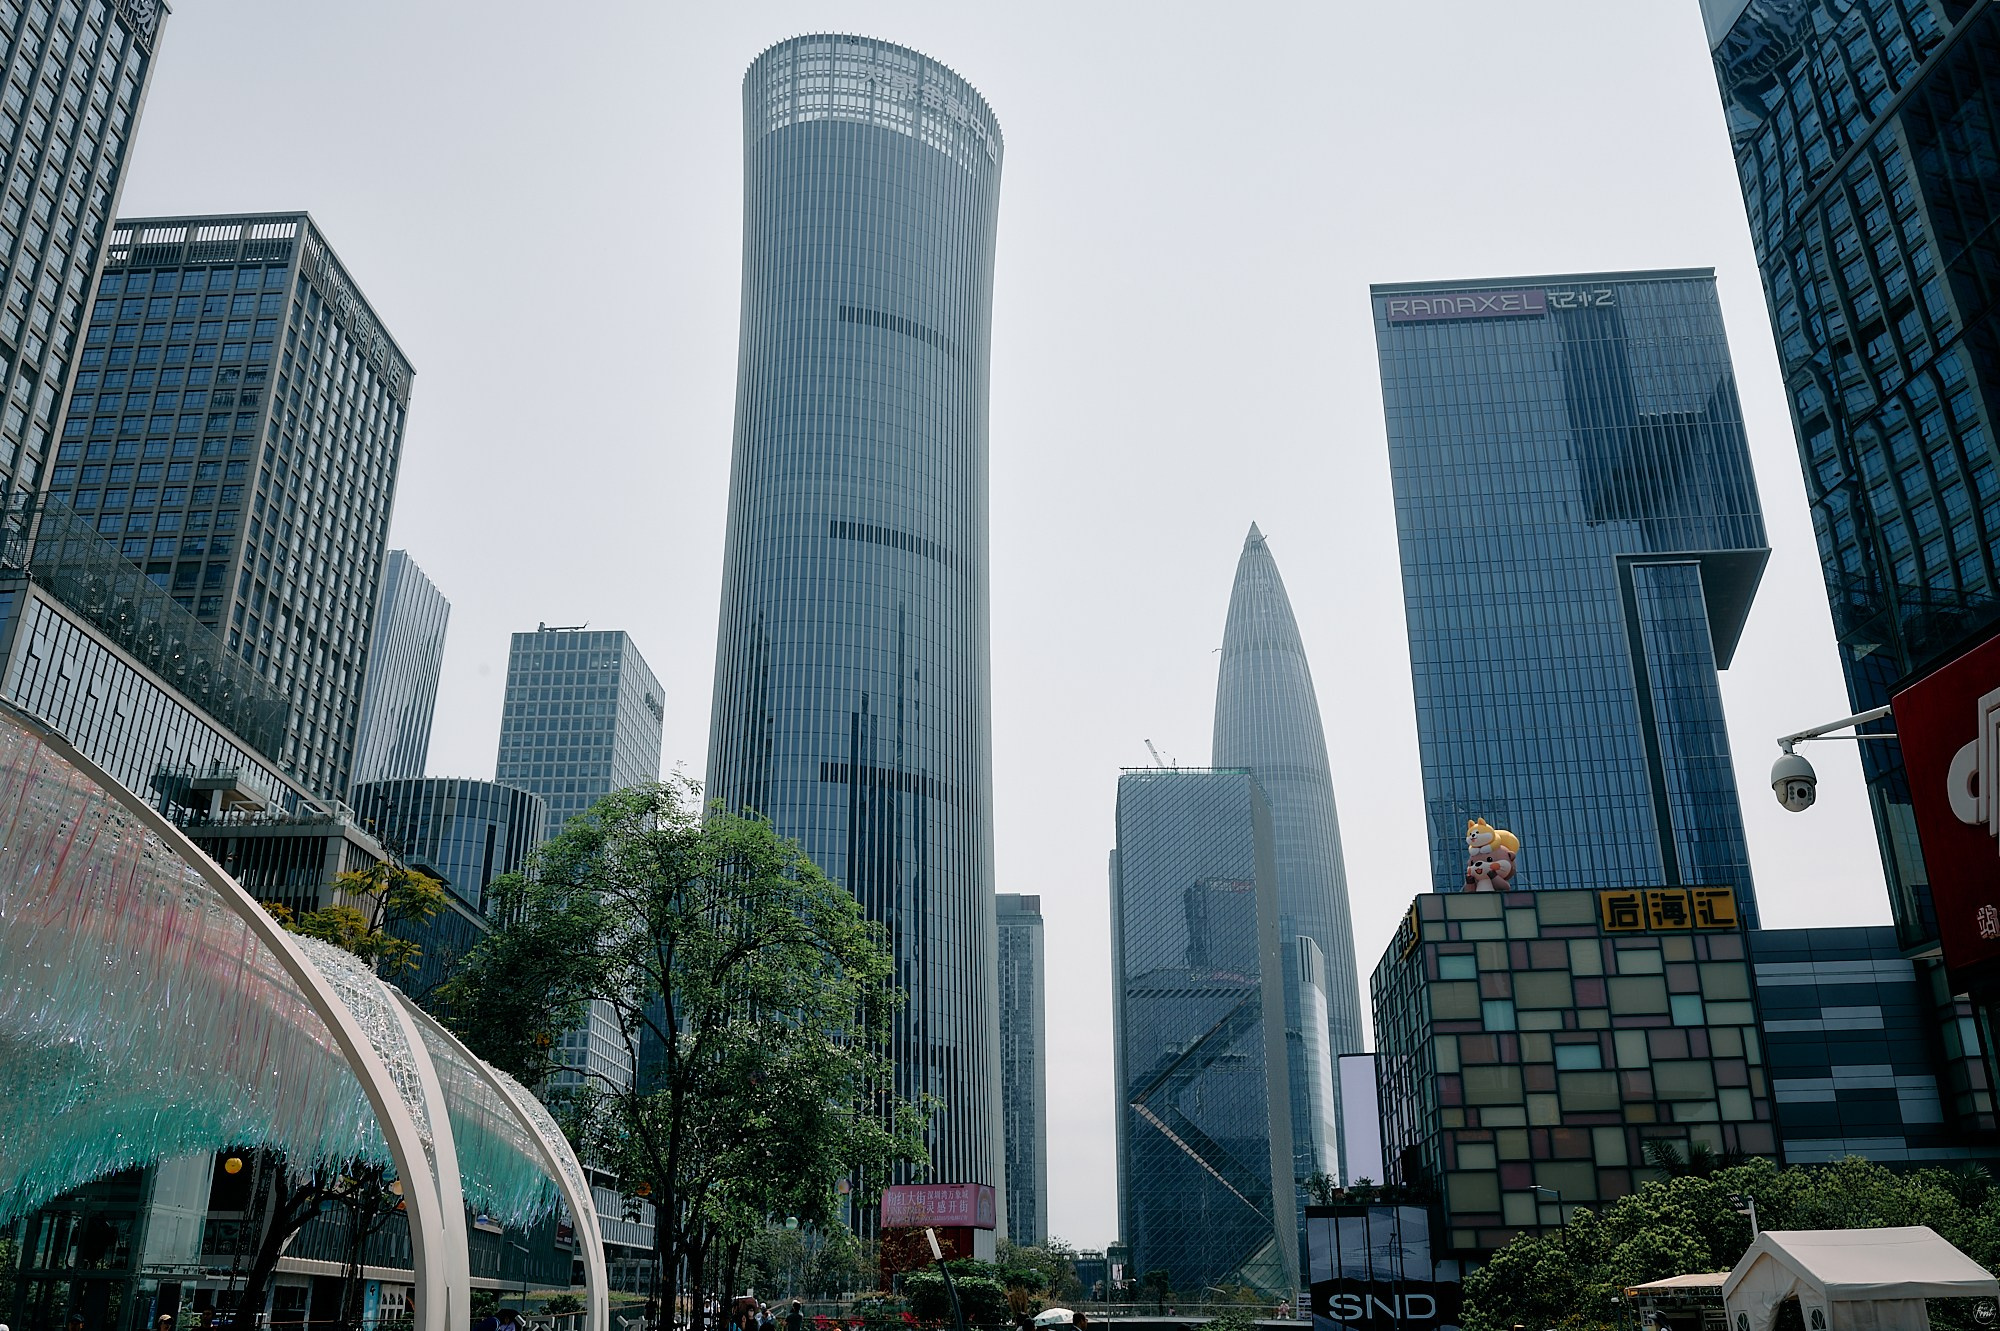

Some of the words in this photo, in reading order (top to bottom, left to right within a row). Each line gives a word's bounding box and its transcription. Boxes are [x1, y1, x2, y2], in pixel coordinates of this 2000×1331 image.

[1390, 294, 1543, 316] RAMAXEL
[1605, 890, 1735, 928] 后海汇
[888, 1191, 926, 1206] 粉红大街
[928, 1190, 968, 1200] 深圳湾万象城
[927, 1200, 968, 1214] 灵感开街
[1328, 1294, 1436, 1320] SND
